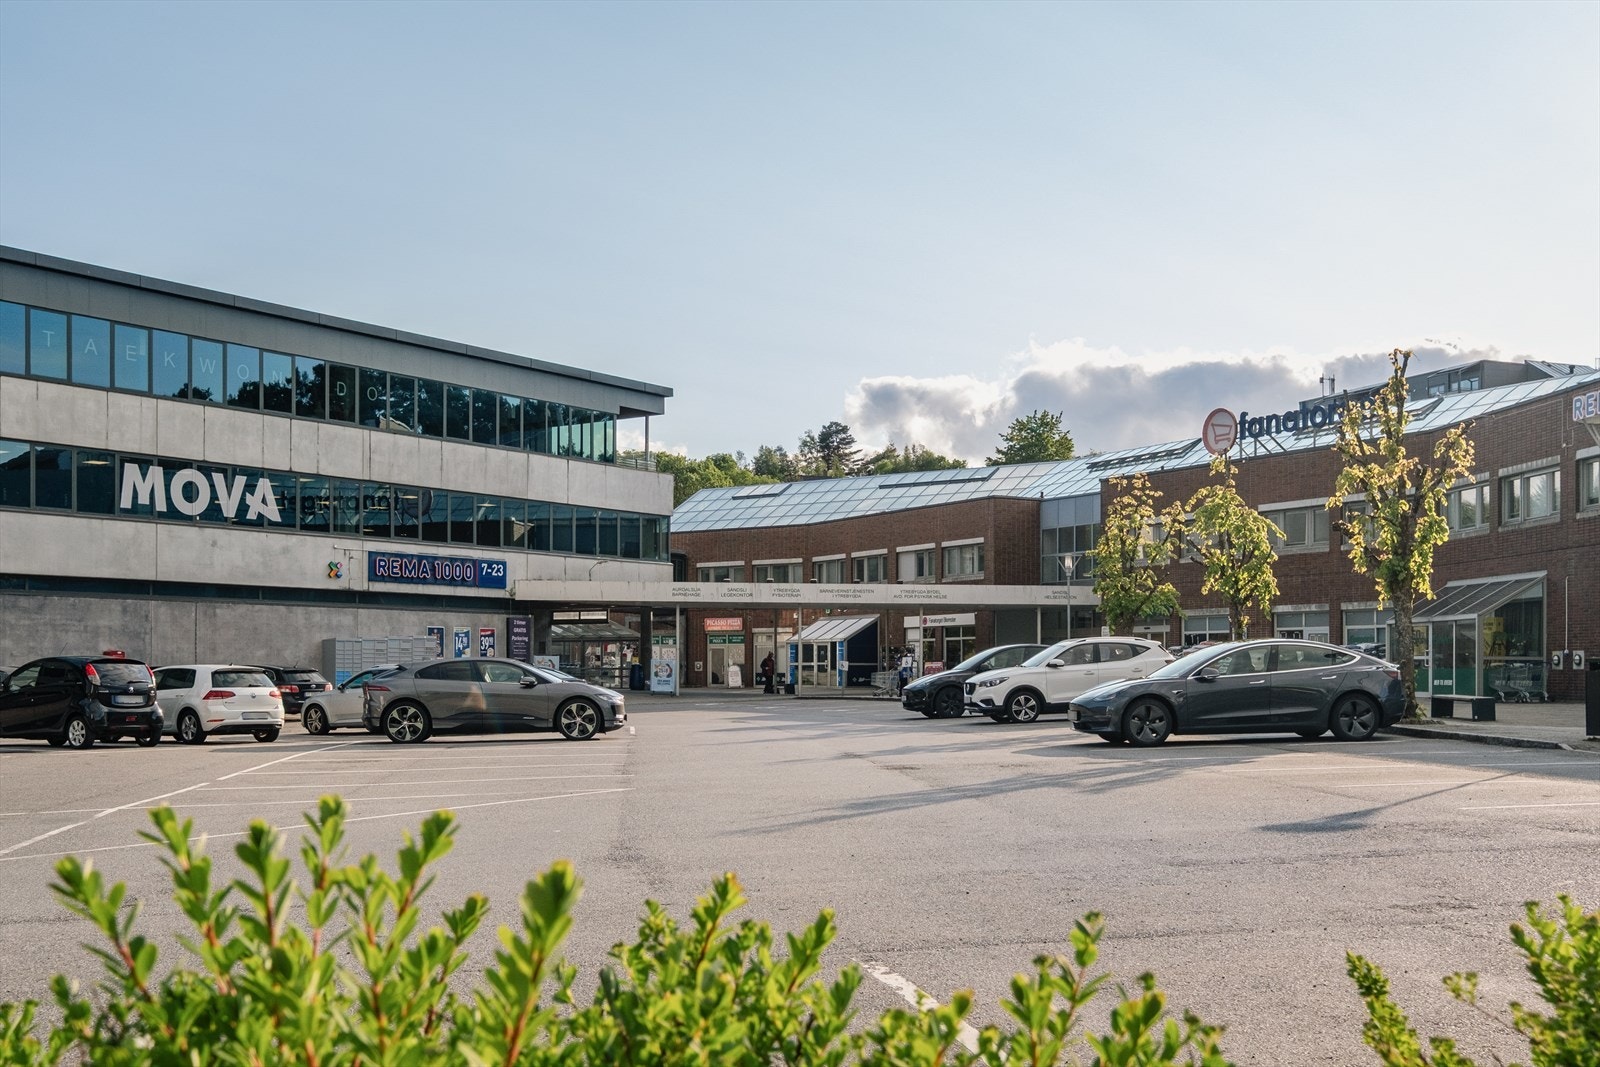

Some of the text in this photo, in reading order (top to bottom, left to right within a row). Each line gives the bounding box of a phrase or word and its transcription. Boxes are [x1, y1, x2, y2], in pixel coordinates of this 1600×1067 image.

[1572, 390, 1600, 421] RE
[120, 463, 281, 522] MOVA
[376, 556, 504, 581] REMA 1000 7-23
[455, 636, 463, 650] 14
[480, 636, 489, 650] 39
